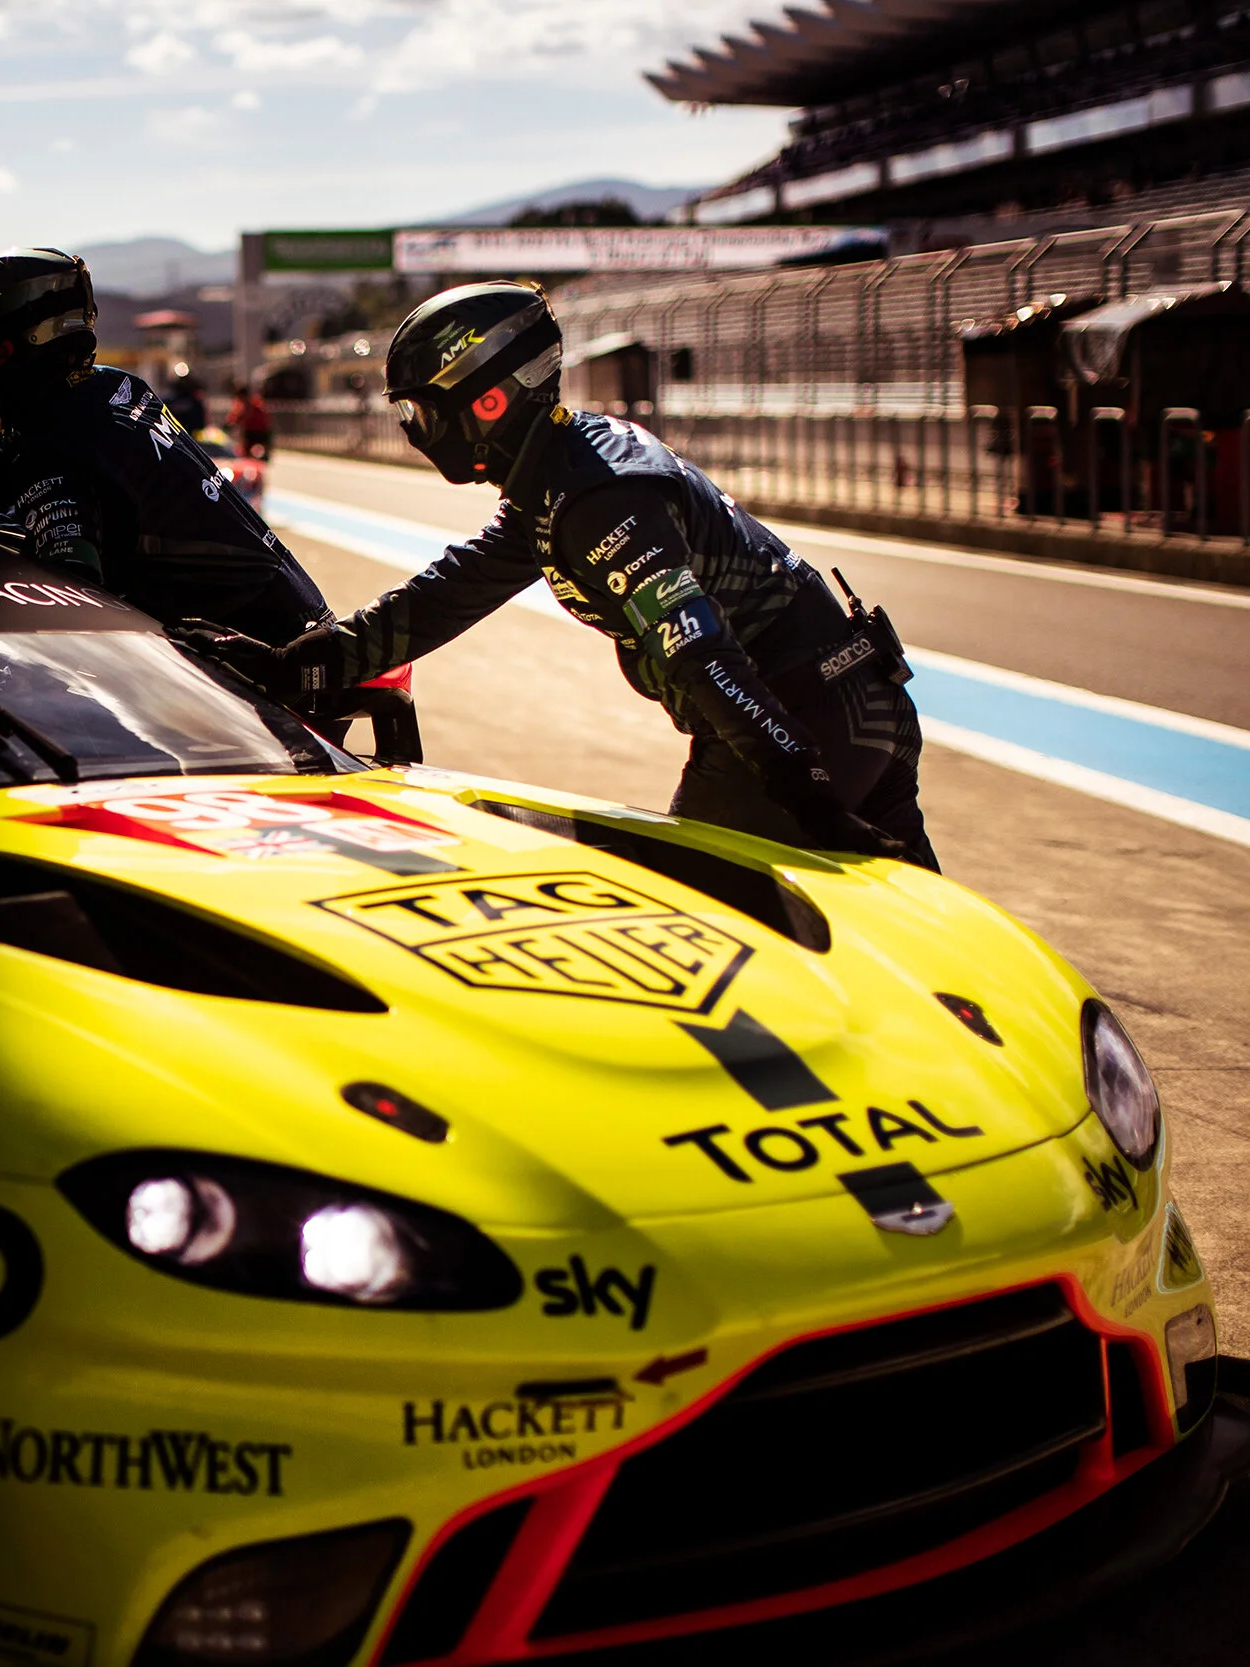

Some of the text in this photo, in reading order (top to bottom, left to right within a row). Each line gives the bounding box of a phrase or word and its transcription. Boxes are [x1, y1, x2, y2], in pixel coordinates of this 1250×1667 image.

[441, 328, 486, 369] AMR
[17, 476, 64, 508] HACKETT
[39, 498, 77, 514] TOTAL
[586, 515, 638, 566] HACKETT
[604, 534, 631, 561] LONDON
[624, 546, 664, 576] TOTAL
[665, 630, 703, 658] LE MANS
[820, 637, 871, 677] sparco
[704, 660, 806, 754] TON MARTIN
[102, 790, 336, 830] 98
[358, 881, 640, 930] TAG
[448, 922, 725, 998] HEUER
[661, 1099, 987, 1184] TOTAL
[1081, 1155, 1139, 1213] sky
[534, 1254, 656, 1331] sky
[402, 1399, 626, 1446] HACKETT
[462, 1440, 578, 1470] LONDON
